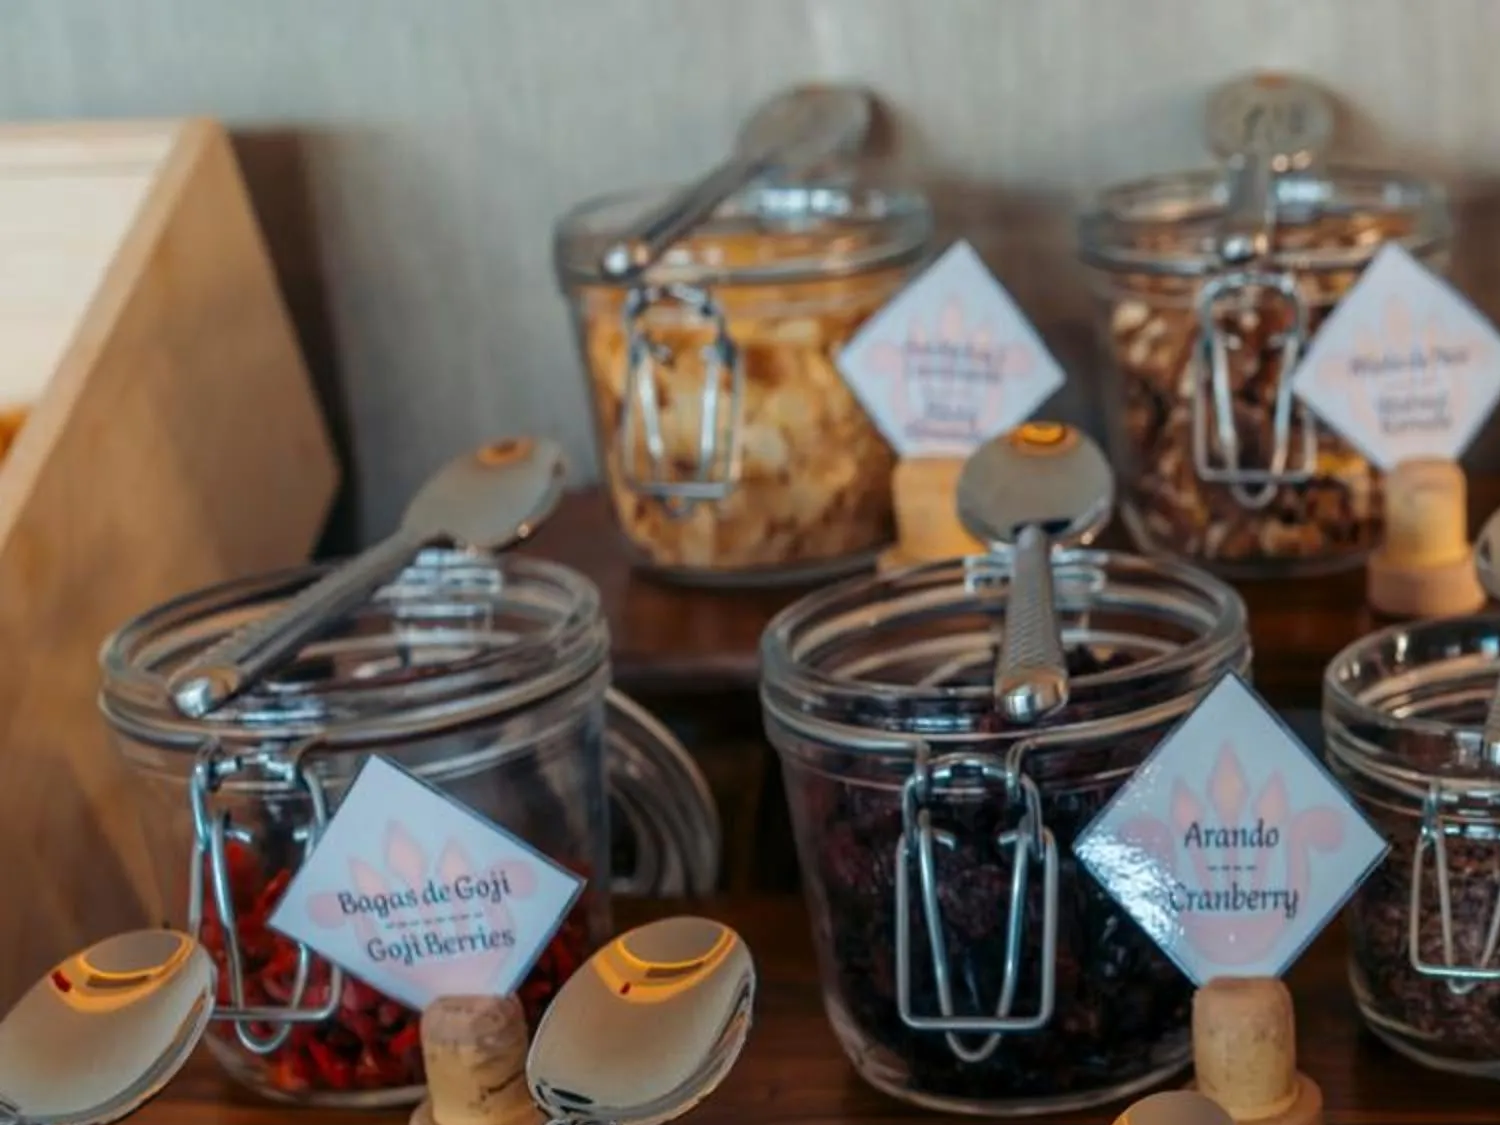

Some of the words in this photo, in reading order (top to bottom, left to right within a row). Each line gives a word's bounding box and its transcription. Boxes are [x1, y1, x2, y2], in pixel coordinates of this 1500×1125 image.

[1183, 818, 1280, 849] Arando
[336, 889, 418, 919] Bagas
[422, 880, 450, 903] de
[454, 868, 513, 903] Goji
[1168, 882, 1299, 920] Cranberry
[366, 934, 422, 967] Goji
[423, 926, 516, 957] Berries
